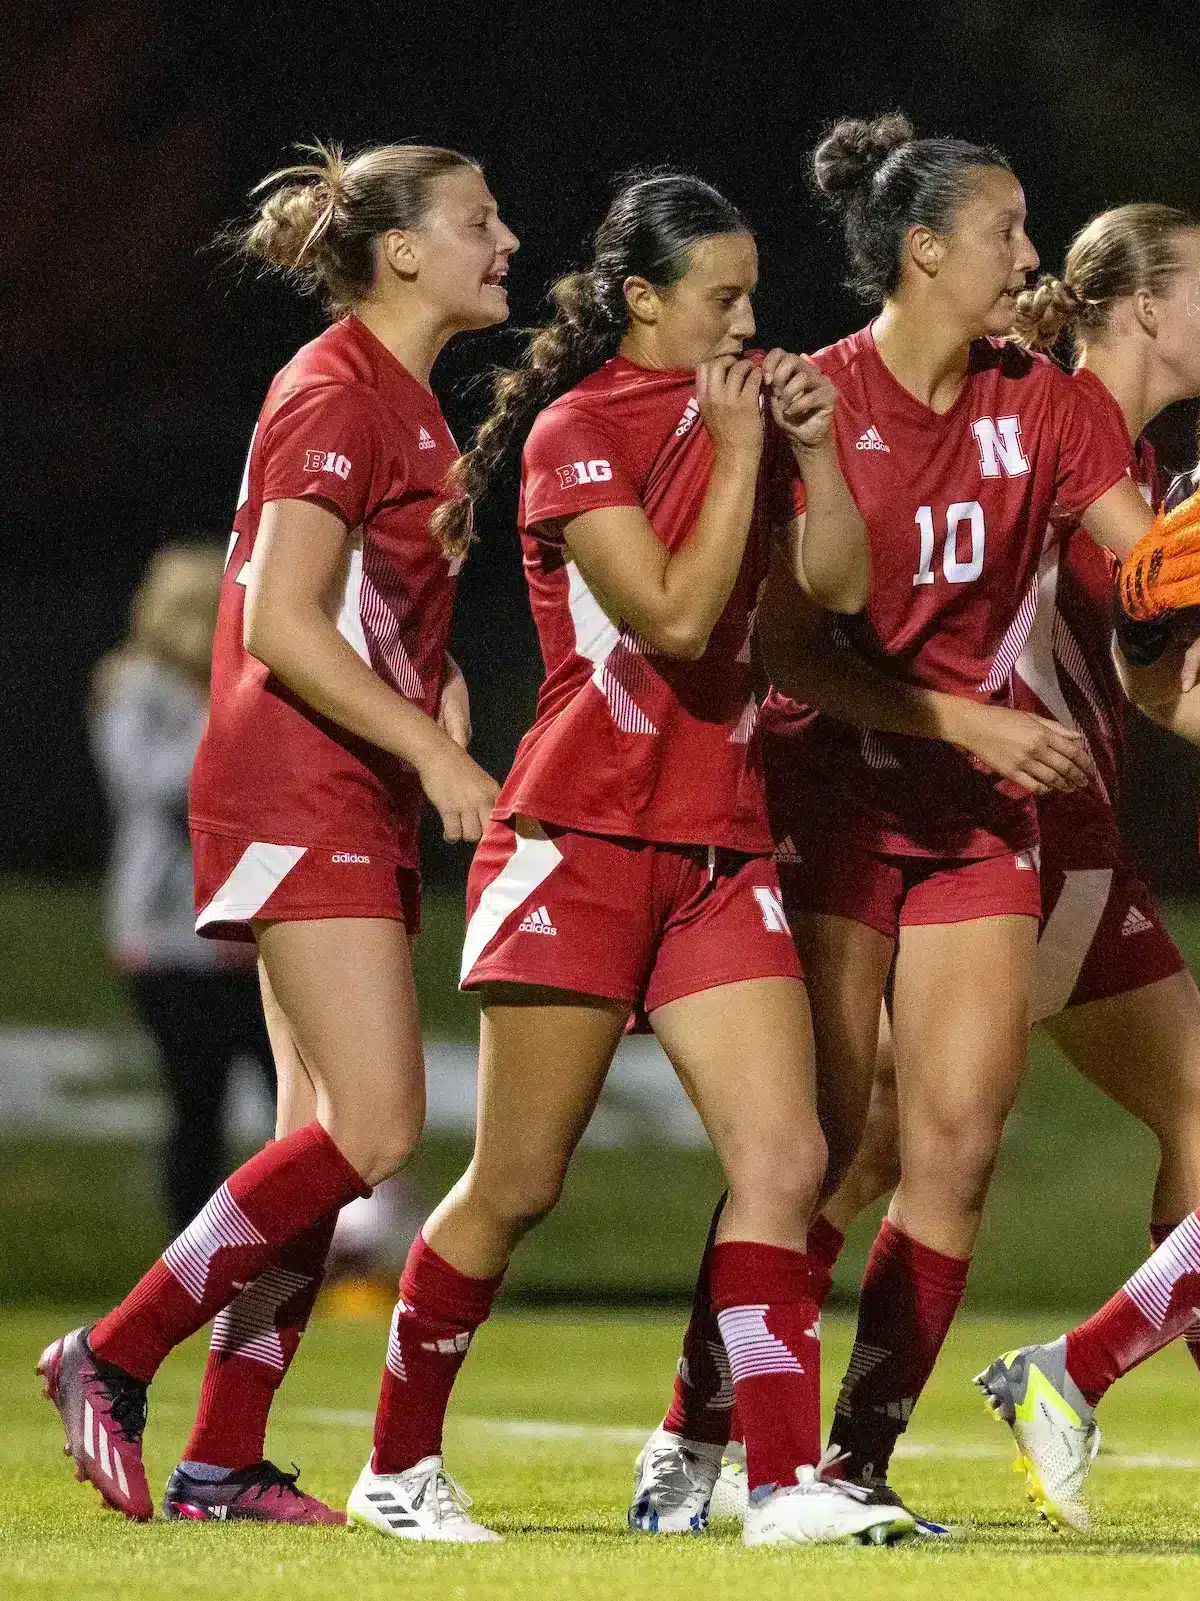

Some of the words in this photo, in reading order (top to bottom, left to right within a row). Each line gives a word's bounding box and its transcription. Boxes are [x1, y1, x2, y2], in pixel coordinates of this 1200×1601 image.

[856, 439, 891, 453] adidas
[970, 414, 1031, 479] N
[913, 501, 985, 586] 10
[332, 852, 370, 864] adidas
[518, 922, 557, 936] adidas
